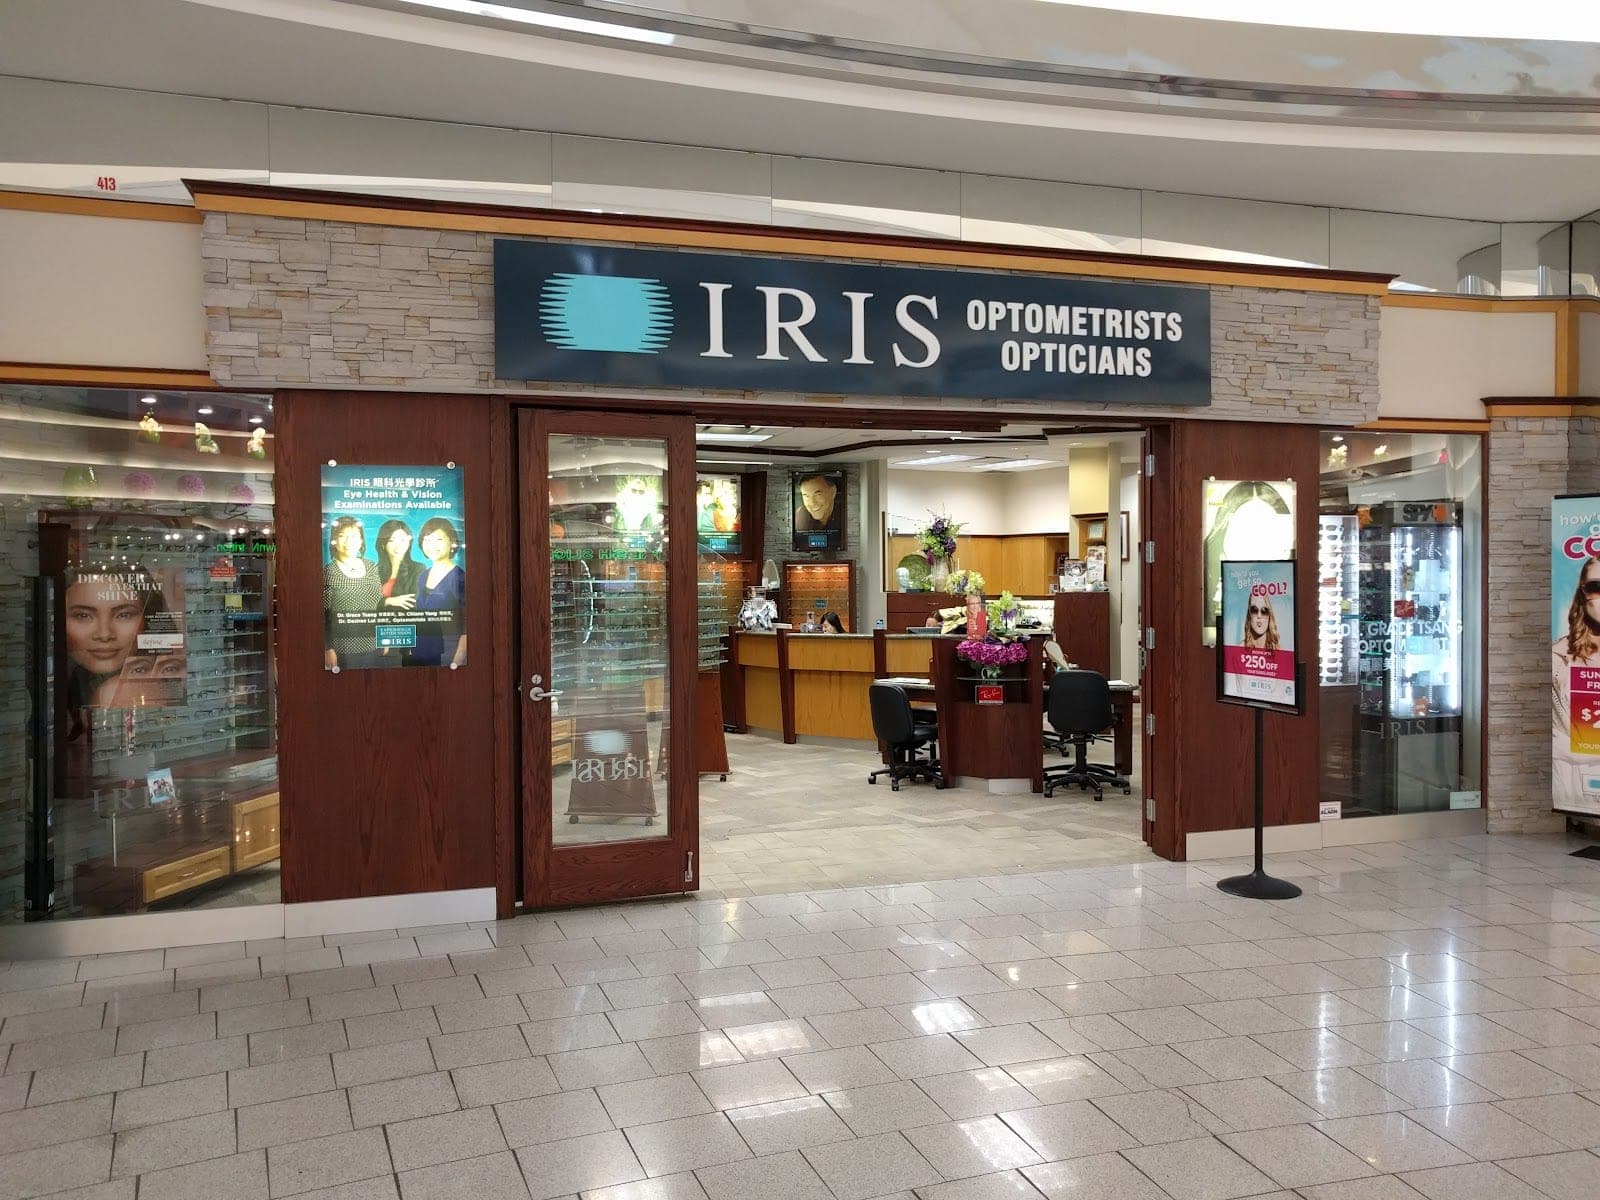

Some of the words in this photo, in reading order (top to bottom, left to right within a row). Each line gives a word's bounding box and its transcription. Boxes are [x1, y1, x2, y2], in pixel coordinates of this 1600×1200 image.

[97, 176, 116, 191] 413
[698, 281, 942, 369] IRIS
[966, 299, 1184, 343] OPTOMETRISTS
[1001, 340, 1152, 378] OPTICIANS
[350, 478, 370, 487] IRIS
[343, 490, 362, 499] Eye
[365, 489, 398, 498] Health
[401, 490, 408, 498] &
[411, 489, 442, 498] Vision
[334, 500, 402, 509] Examinations
[405, 500, 451, 509] Available
[1403, 504, 1433, 521] SPY
[97, 591, 138, 600] SHINE
[1252, 582, 1287, 597] COOL?
[1240, 654, 1266, 669] $250
[1257, 681, 1271, 689] IRIS
[1377, 720, 1426, 739] IRIS
